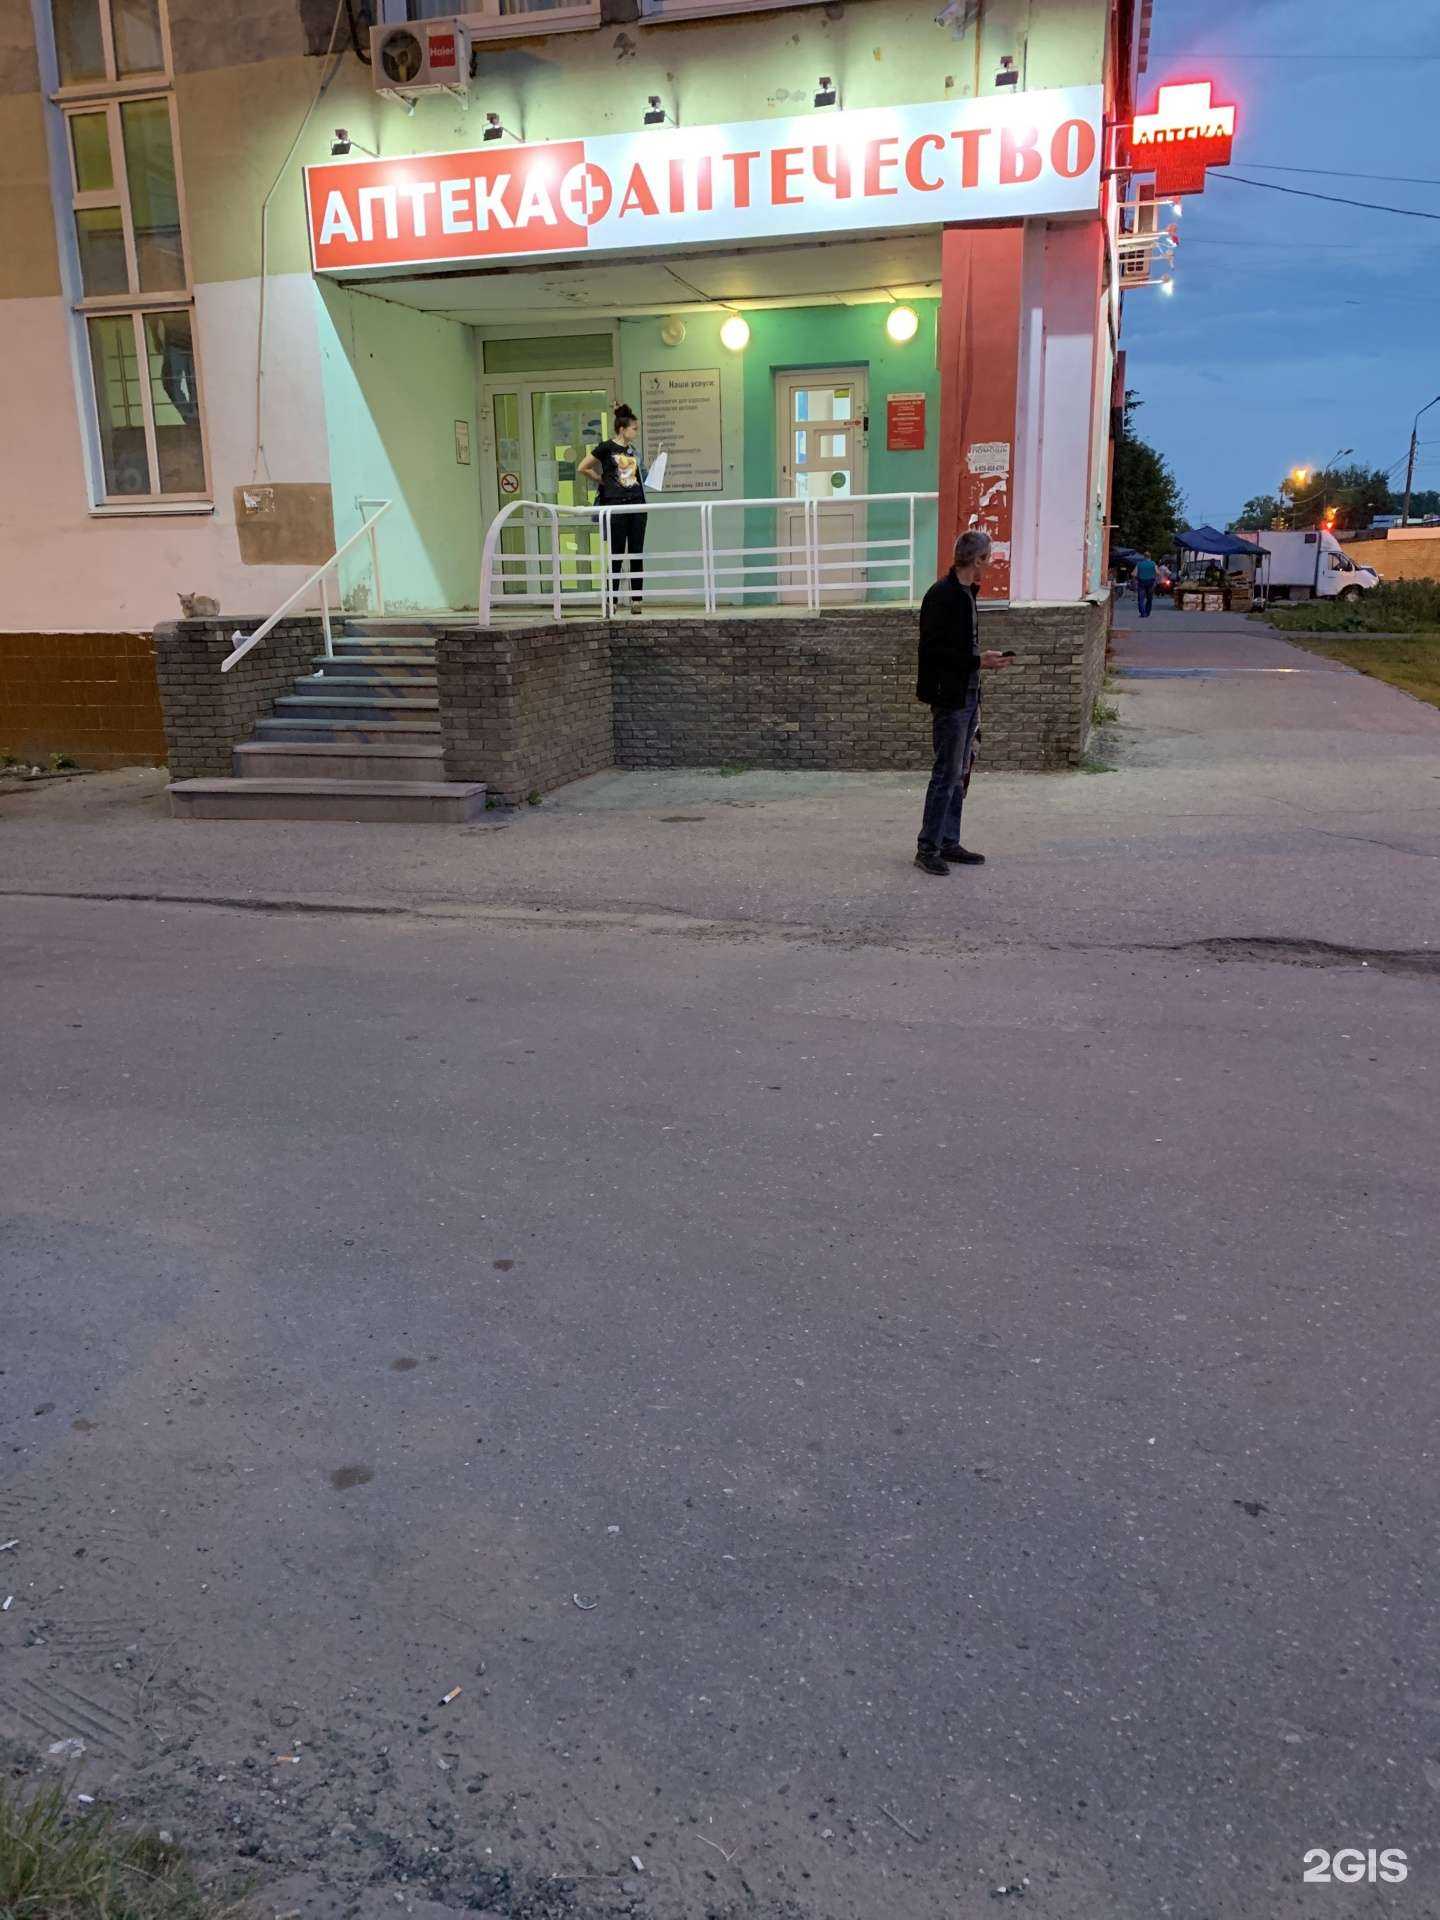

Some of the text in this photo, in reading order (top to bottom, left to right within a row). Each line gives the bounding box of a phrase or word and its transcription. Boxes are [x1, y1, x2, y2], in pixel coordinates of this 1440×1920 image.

[430, 46, 455, 57] Haier
[319, 118, 1096, 245] АПТЕКА АПТЕЧЕСТВО
